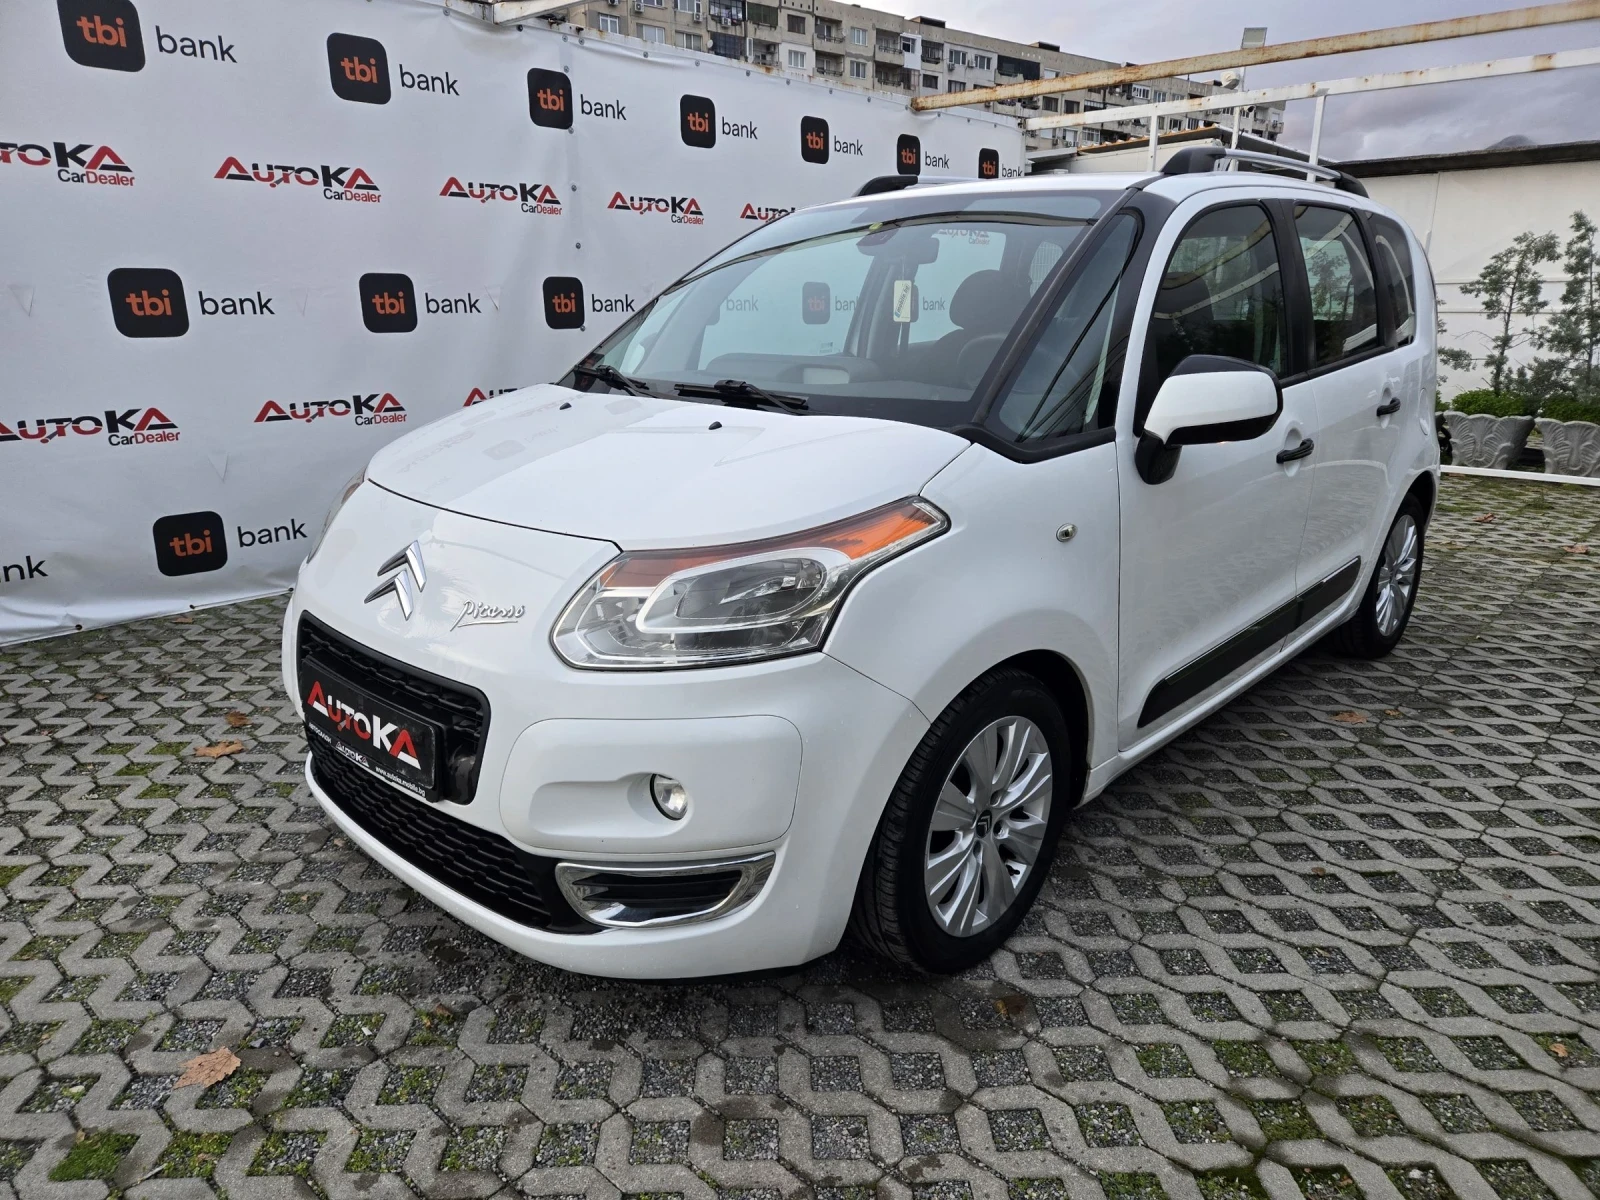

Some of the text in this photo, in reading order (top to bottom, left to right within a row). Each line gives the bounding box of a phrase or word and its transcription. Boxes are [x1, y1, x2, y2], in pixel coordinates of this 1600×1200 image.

[76, 15, 237, 63] tbi bank
[340, 57, 460, 96] tbi bank
[537, 88, 626, 120] tbi bank
[687, 112, 758, 140] tbi bank
[806, 132, 863, 156] tbi bank
[901, 148, 949, 169] tbi bank
[983, 160, 1023, 178] tbi bank
[57, 169, 135, 187] CarDealer
[214, 156, 380, 191] AUTOKA
[323, 187, 382, 203] CarDealer
[439, 177, 561, 205] AUTOKA
[521, 202, 562, 216] CarDealer
[607, 191, 703, 217] AUTOKA
[670, 213, 705, 225] CarDealer
[126, 289, 275, 316] tbi bank
[372, 291, 482, 314] tbi bank
[552, 292, 635, 313] tbi bank
[726, 295, 759, 312] bank
[808, 296, 825, 312] tbi
[922, 296, 946, 311] bank
[254, 392, 406, 423] AUTOKA
[354, 412, 407, 426] CarDealer
[108, 430, 180, 446] CarDealer
[169, 519, 308, 557] tbi bank
[0, 555, 49, 583] nk
[450, 599, 526, 632] Picasso
[307, 681, 421, 770] AUTOKA
